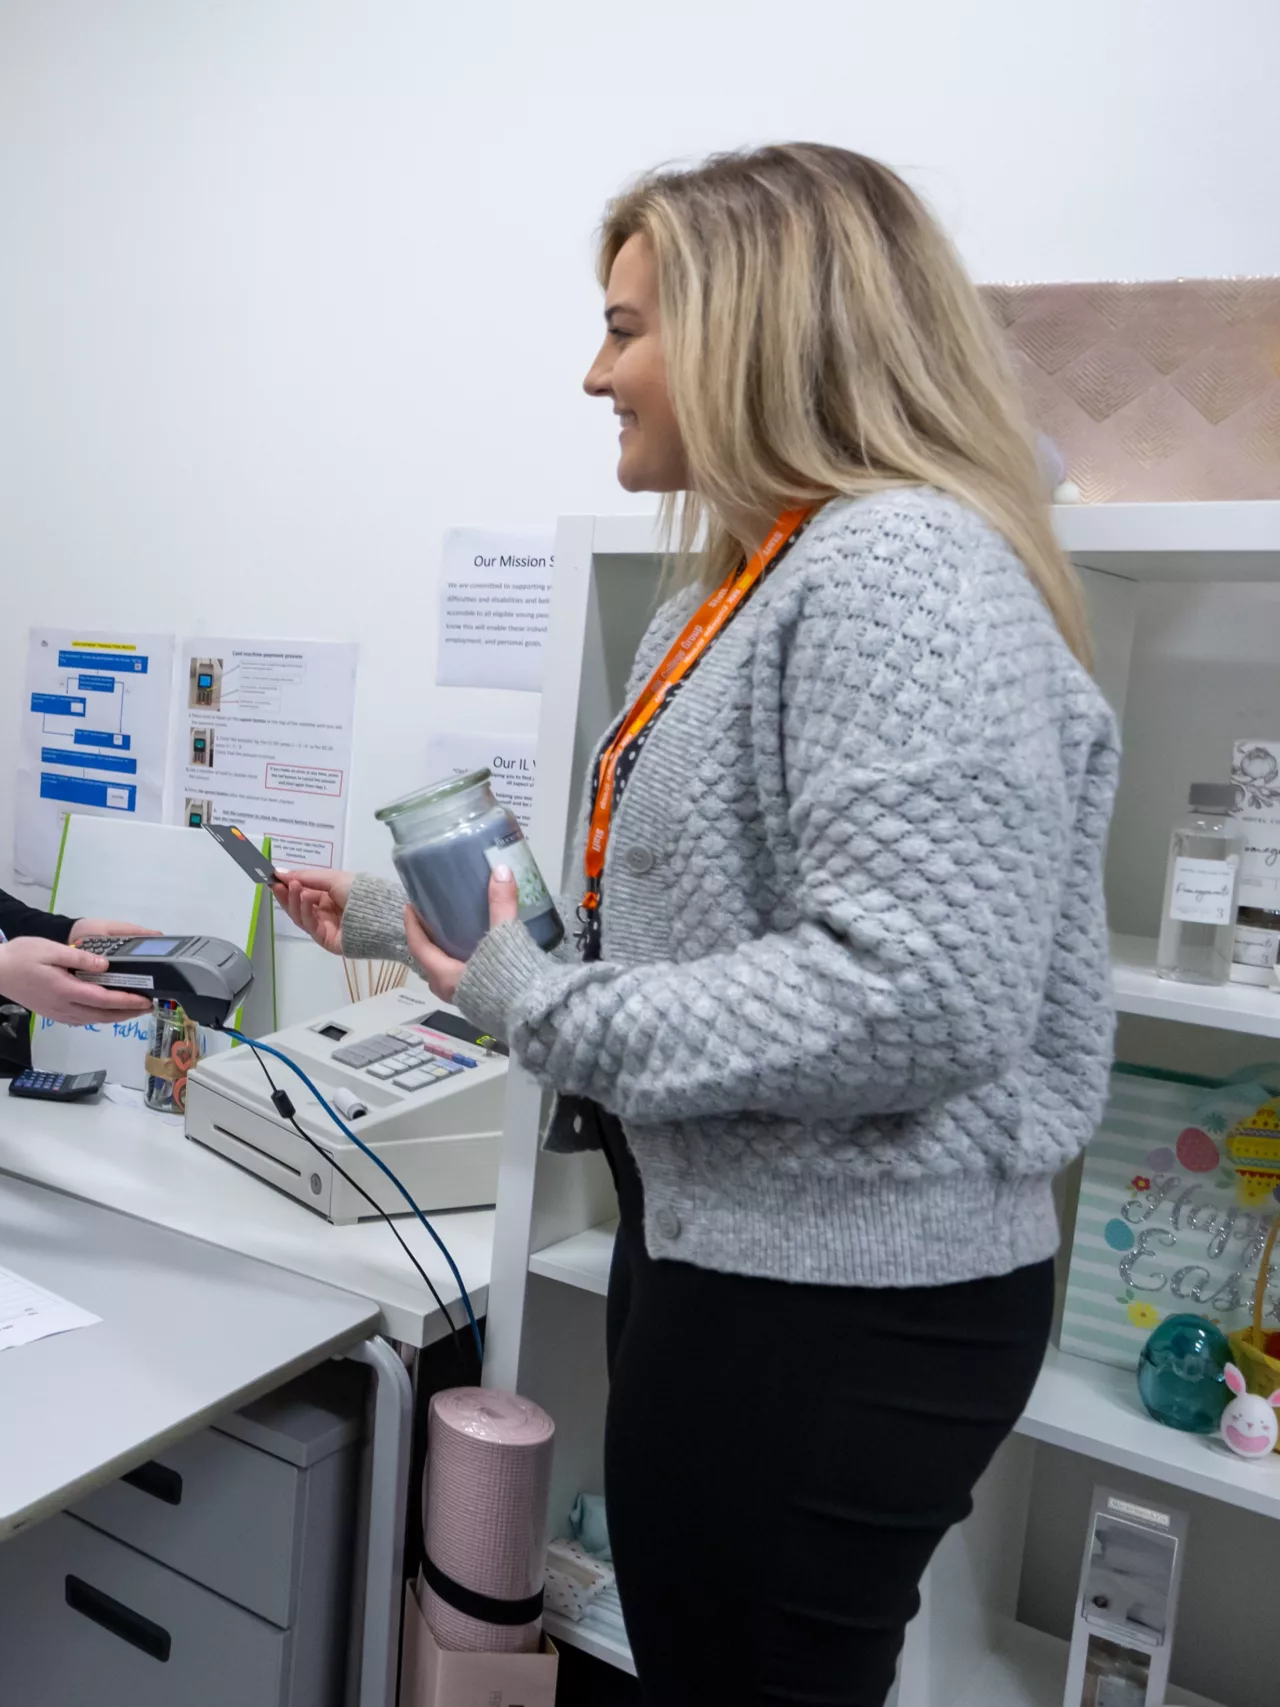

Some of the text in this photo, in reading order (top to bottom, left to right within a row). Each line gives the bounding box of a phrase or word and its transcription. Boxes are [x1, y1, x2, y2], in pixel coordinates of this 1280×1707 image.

[473, 555, 497, 568] Our
[499, 555, 546, 568] Mission
[493, 756, 516, 769] Our
[592, 827, 605, 852] Staff
